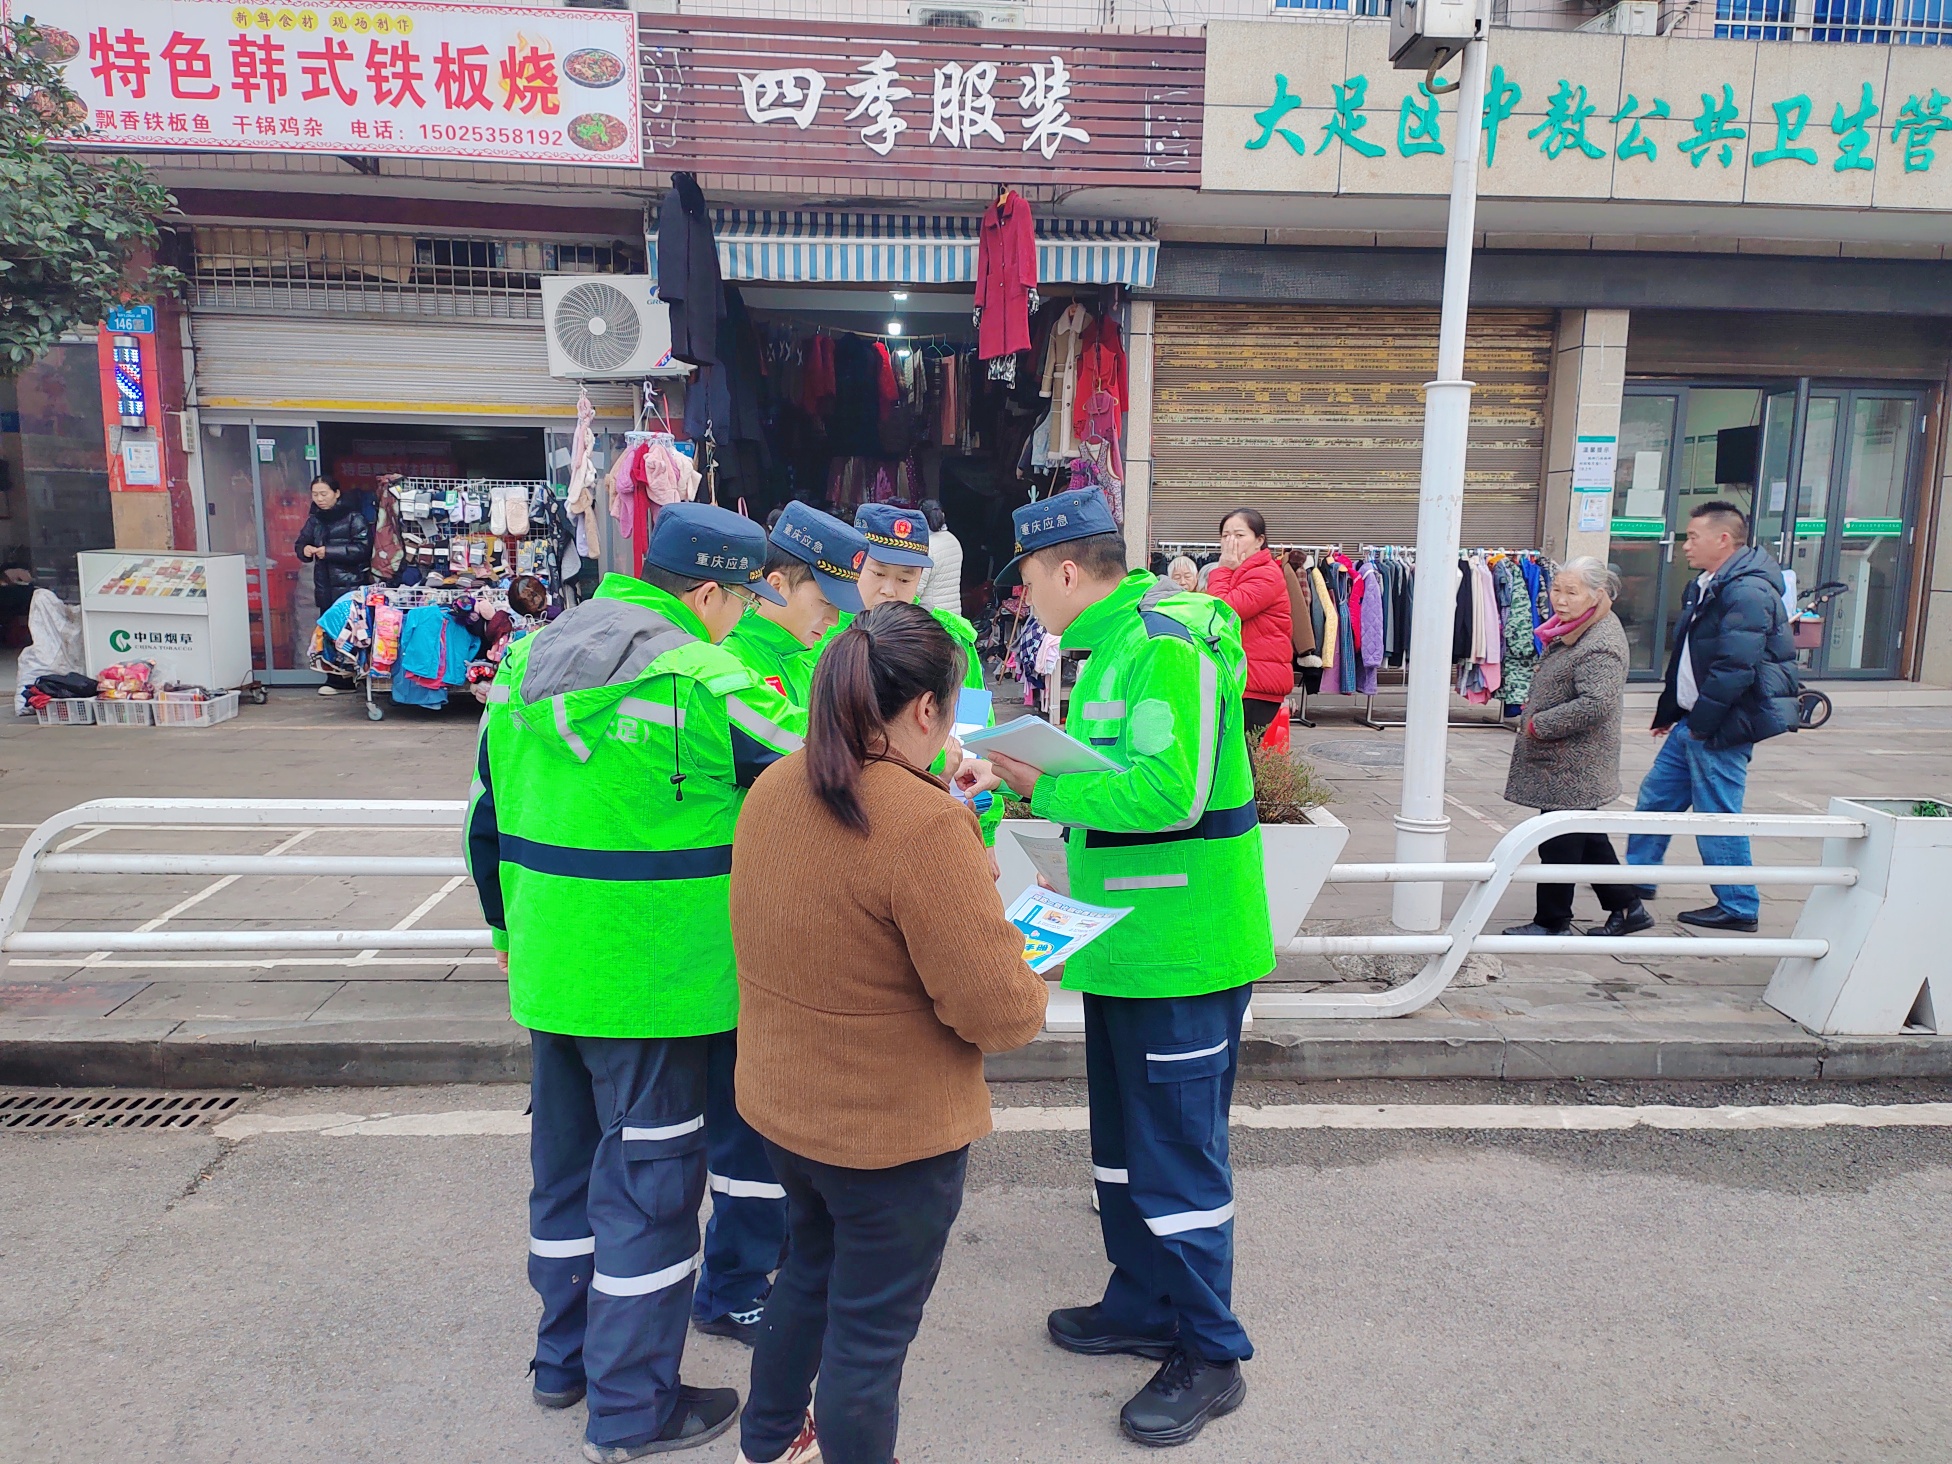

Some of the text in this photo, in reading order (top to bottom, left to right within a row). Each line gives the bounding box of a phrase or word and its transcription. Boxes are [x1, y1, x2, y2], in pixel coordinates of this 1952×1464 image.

[235, 11, 410, 32] 新鲜食材 现场制作
[88, 27, 561, 116] 特色韩式铁板烧
[736, 49, 1091, 161] 四季服装
[95, 109, 212, 134] 飘香铁板鱼
[232, 115, 323, 137] 干锅鸡杂
[419, 124, 564, 147] 15025358192
[114, 318, 133, 330] 146
[1020, 514, 1069, 536] 重庆应急
[783, 523, 823, 554] 重庆应急
[695, 552, 749, 570] 重庆应急
[134, 631, 193, 645] 中国烟草
